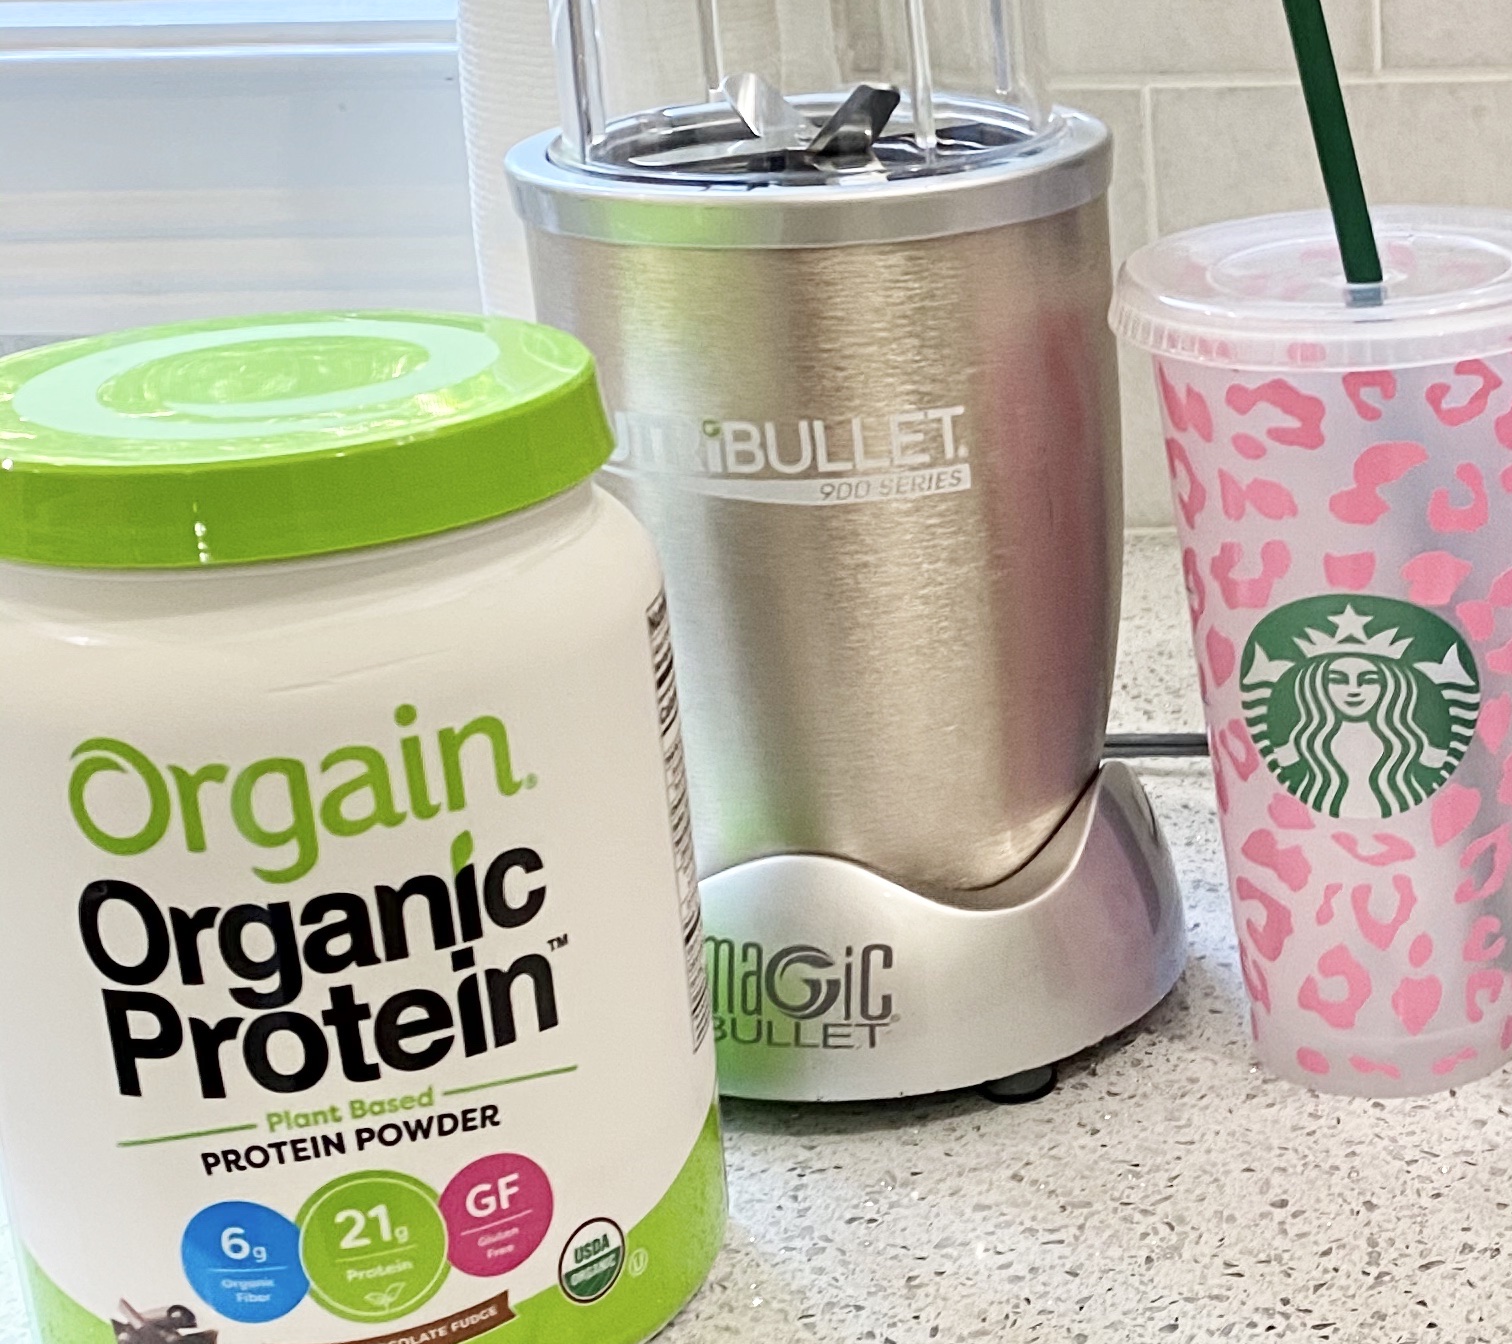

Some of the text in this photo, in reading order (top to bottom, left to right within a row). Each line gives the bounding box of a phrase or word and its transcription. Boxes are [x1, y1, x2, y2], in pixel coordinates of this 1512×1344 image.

[879, 471, 962, 497] SERIES
[68, 703, 523, 885] Orgain
[78, 830, 547, 1009] Organic
[101, 946, 559, 1099] Protein
[714, 1014, 890, 1049] BULLET
[266, 1087, 434, 1133] Plant Based
[201, 1104, 501, 1176] PROTEIN POWDER
[465, 1172, 520, 1218] GF
[574, 1233, 610, 1264] USDA
[221, 1277, 275, 1291] Organic
[346, 1258, 414, 1282] Protein
[236, 1292, 272, 1304] Fiber
[451, 1305, 498, 1332] FUDGE
